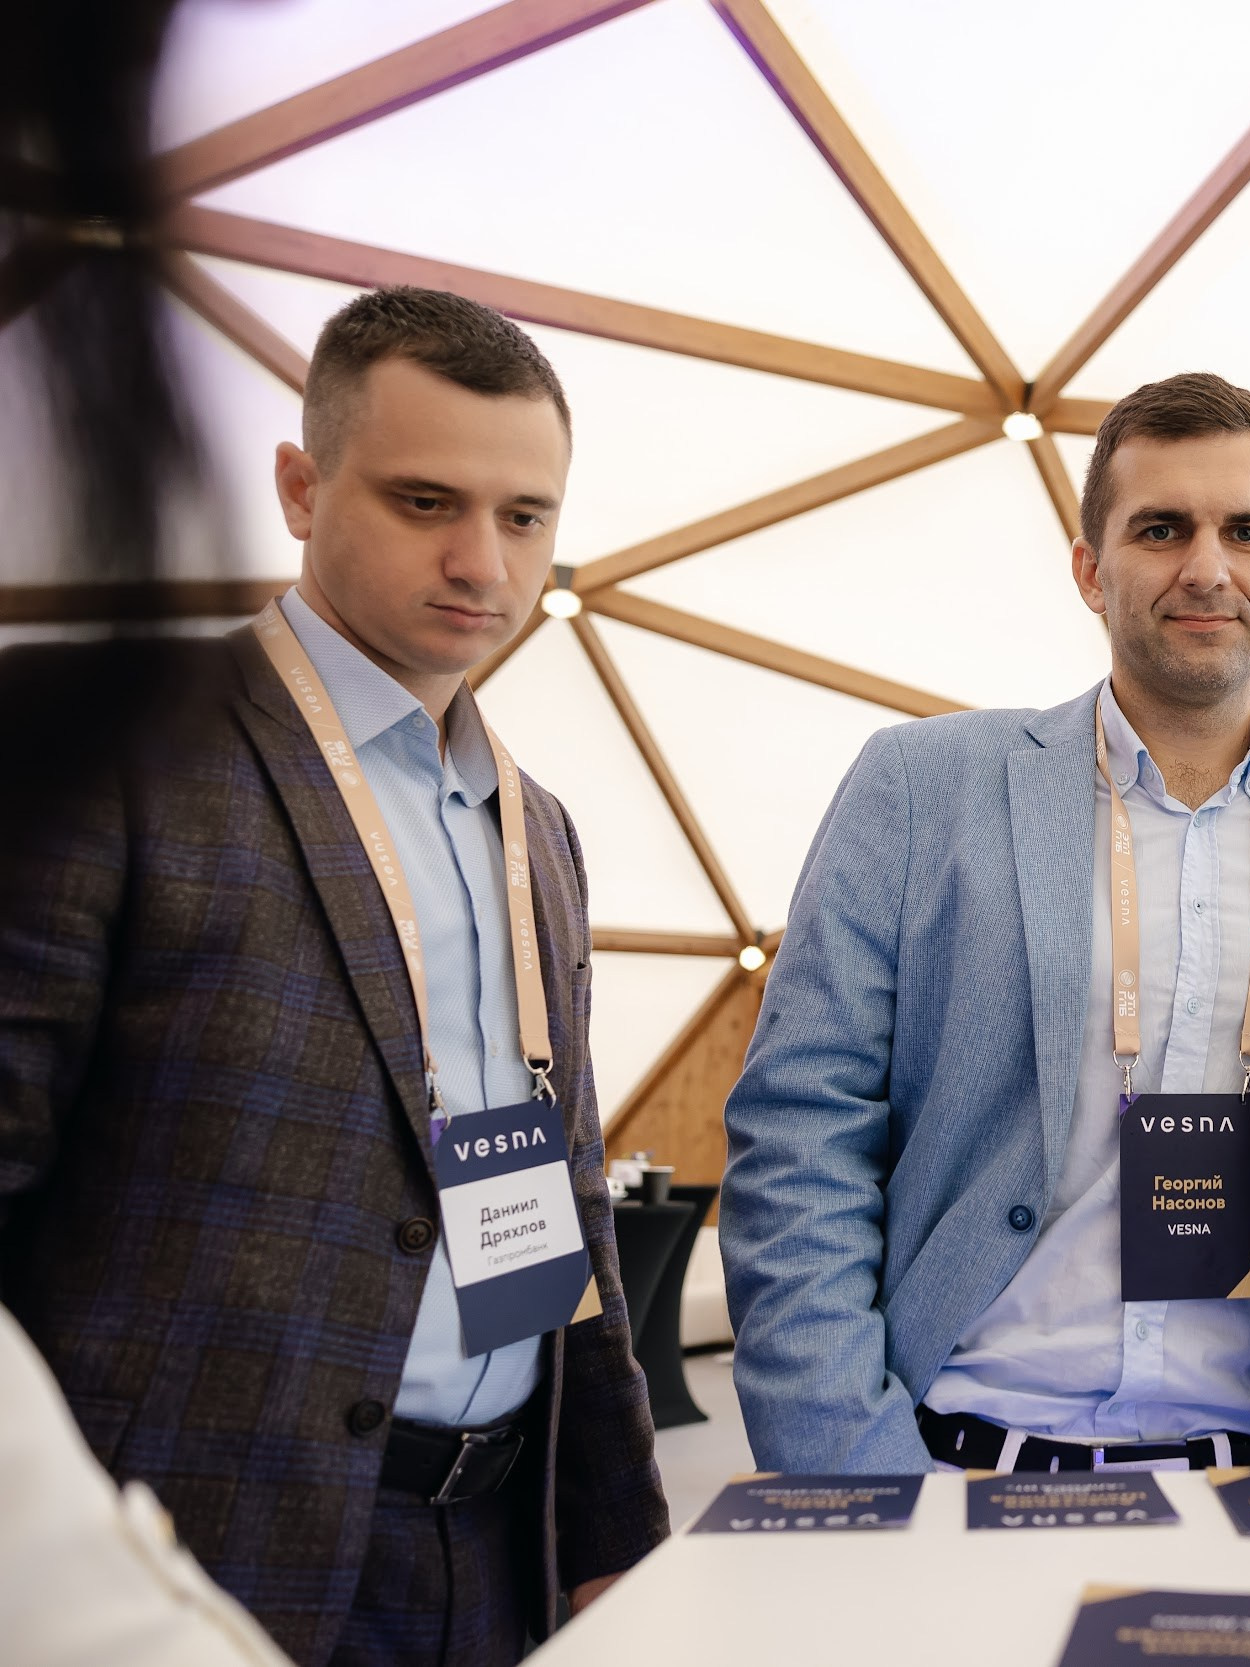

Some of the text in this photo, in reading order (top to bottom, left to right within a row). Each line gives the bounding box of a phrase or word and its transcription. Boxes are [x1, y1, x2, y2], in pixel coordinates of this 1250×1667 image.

[1154, 1174, 1223, 1194] Георгий
[480, 1198, 539, 1226] Даниил
[1152, 1195, 1226, 1211] Насонов
[480, 1219, 547, 1250] Дряхлов
[1167, 1223, 1212, 1236] VESNA
